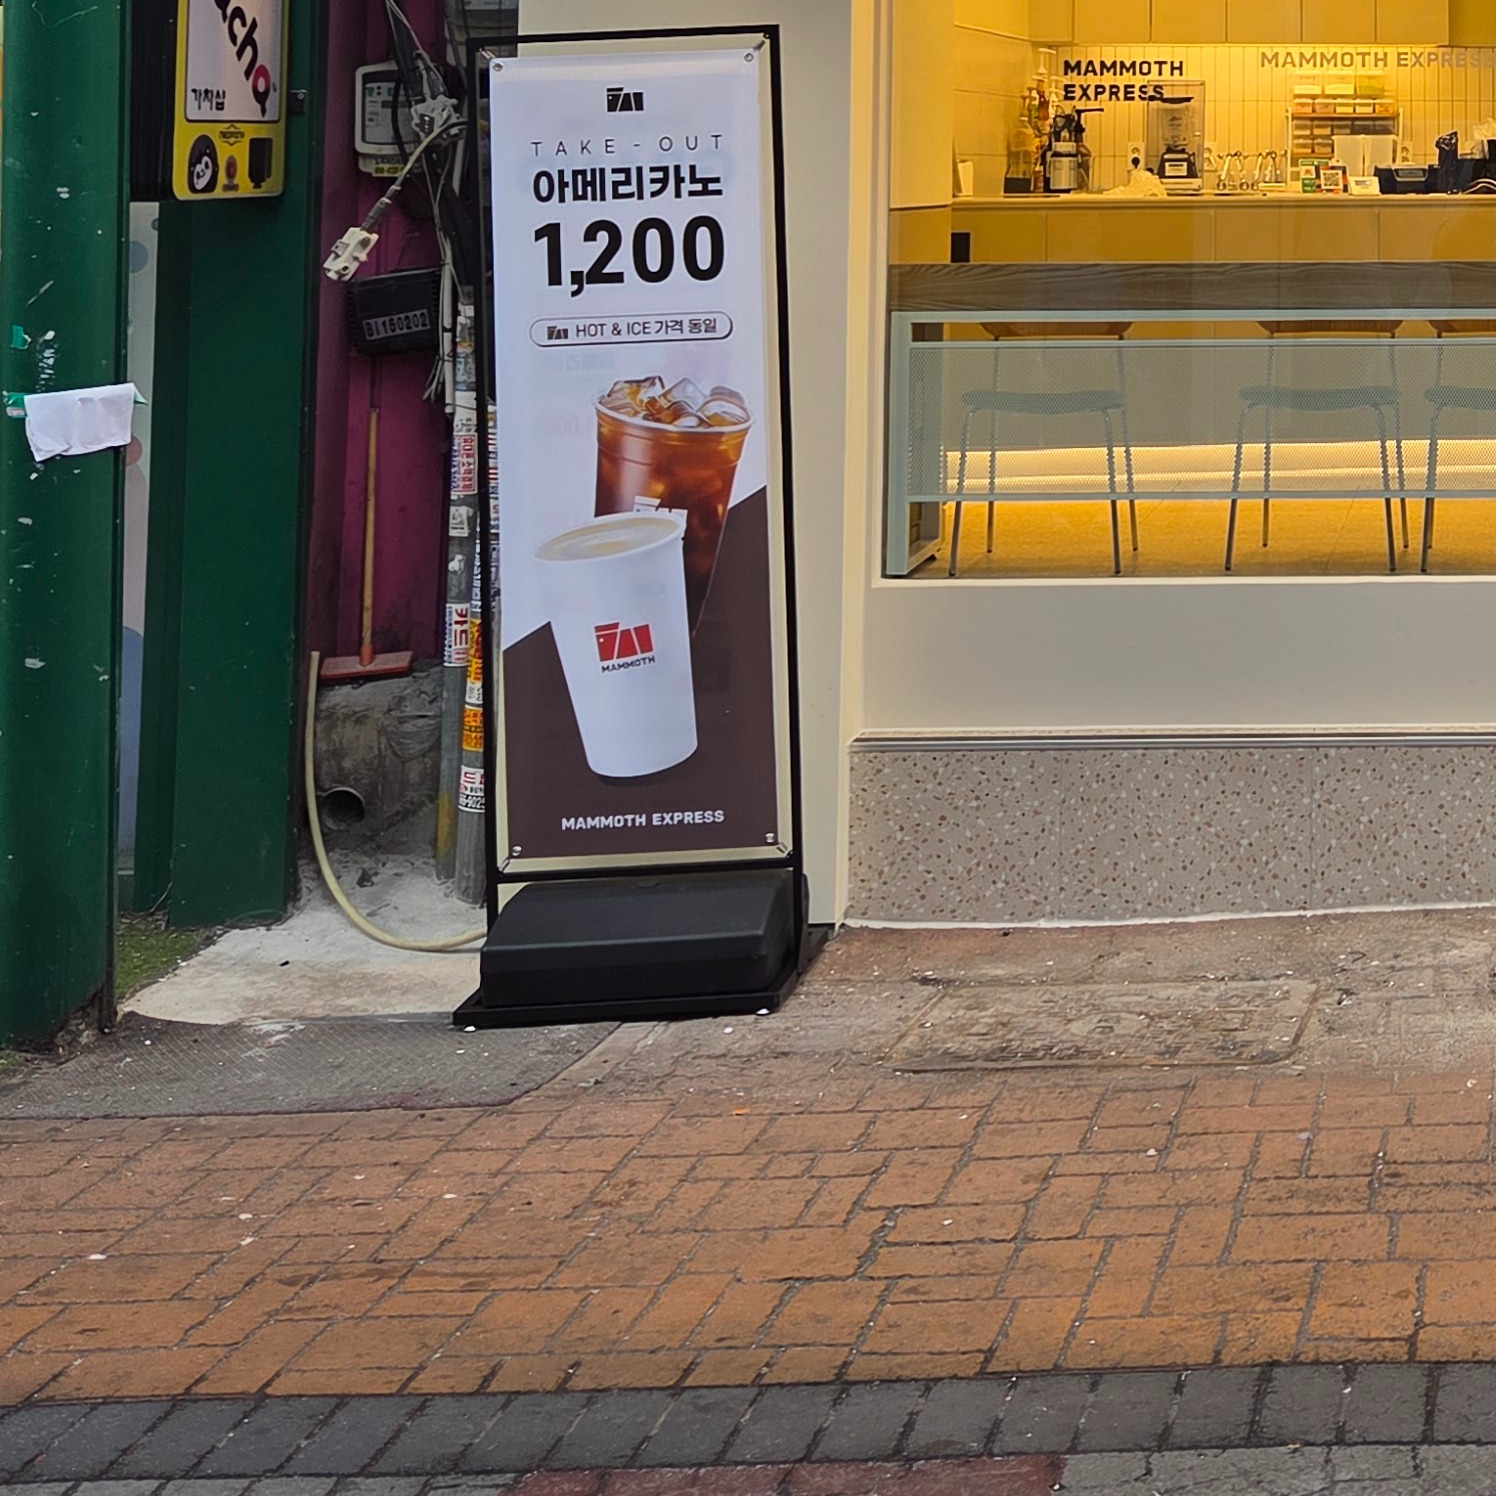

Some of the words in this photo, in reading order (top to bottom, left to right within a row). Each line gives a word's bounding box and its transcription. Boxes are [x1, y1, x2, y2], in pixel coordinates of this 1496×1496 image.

[1063, 60, 1184, 76] MAMMOTH
[1261, 51, 1388, 68] MAMMOTH
[1063, 84, 1164, 101] EXPRESS
[533, 164, 723, 203] 아메리카노
[534, 215, 725, 298] 1,200
[576, 323, 606, 337] HOT
[611, 322, 622, 336] &
[627, 321, 651, 336] ICE
[654, 319, 684, 335] 가격
[688, 318, 717, 334] 동일
[601, 655, 655, 673] MAMMOTH
[561, 814, 646, 830] MAMMOTH
[652, 810, 725, 825] EXPRESS
